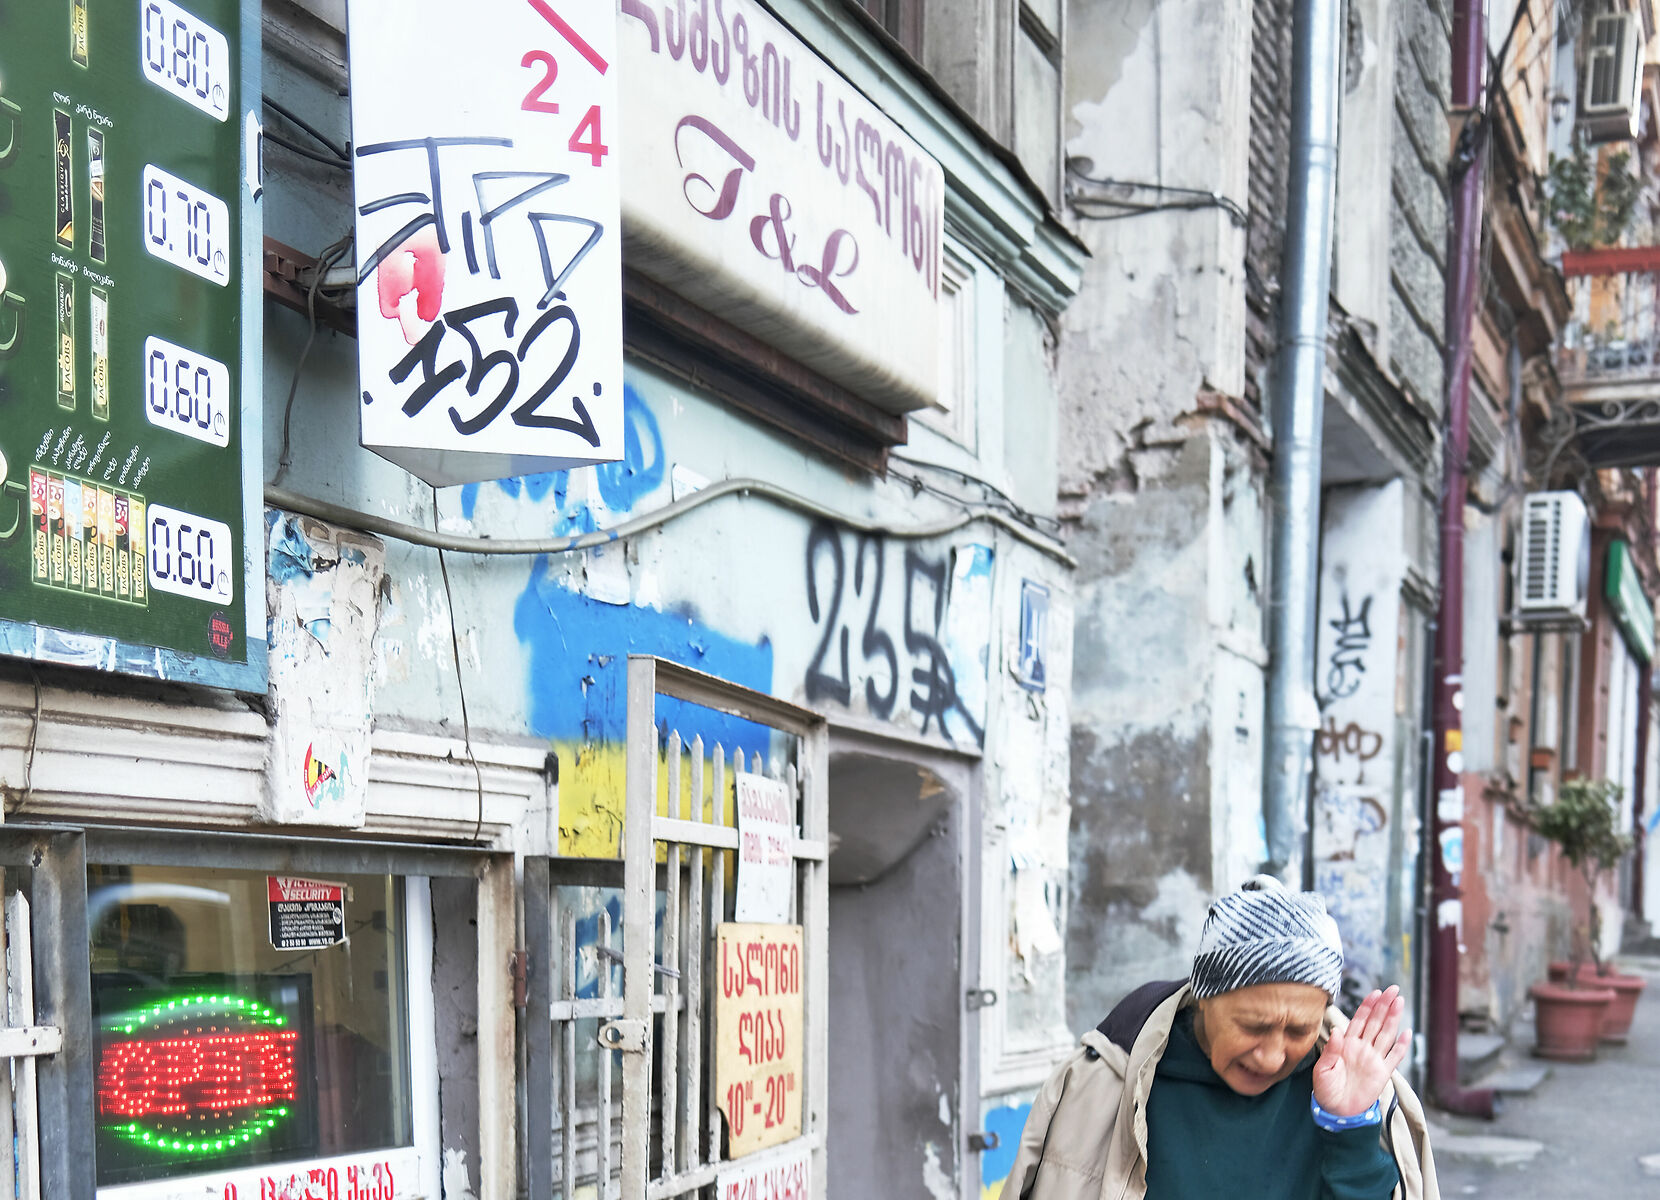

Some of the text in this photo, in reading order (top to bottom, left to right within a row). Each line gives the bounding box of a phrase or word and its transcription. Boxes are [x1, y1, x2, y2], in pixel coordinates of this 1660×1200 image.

[816, 80, 939, 303] სალონი
[290, 888, 332, 901] SECURITY
[722, 941, 799, 999] სალონი
[108, 1031, 298, 1118] OPEN
